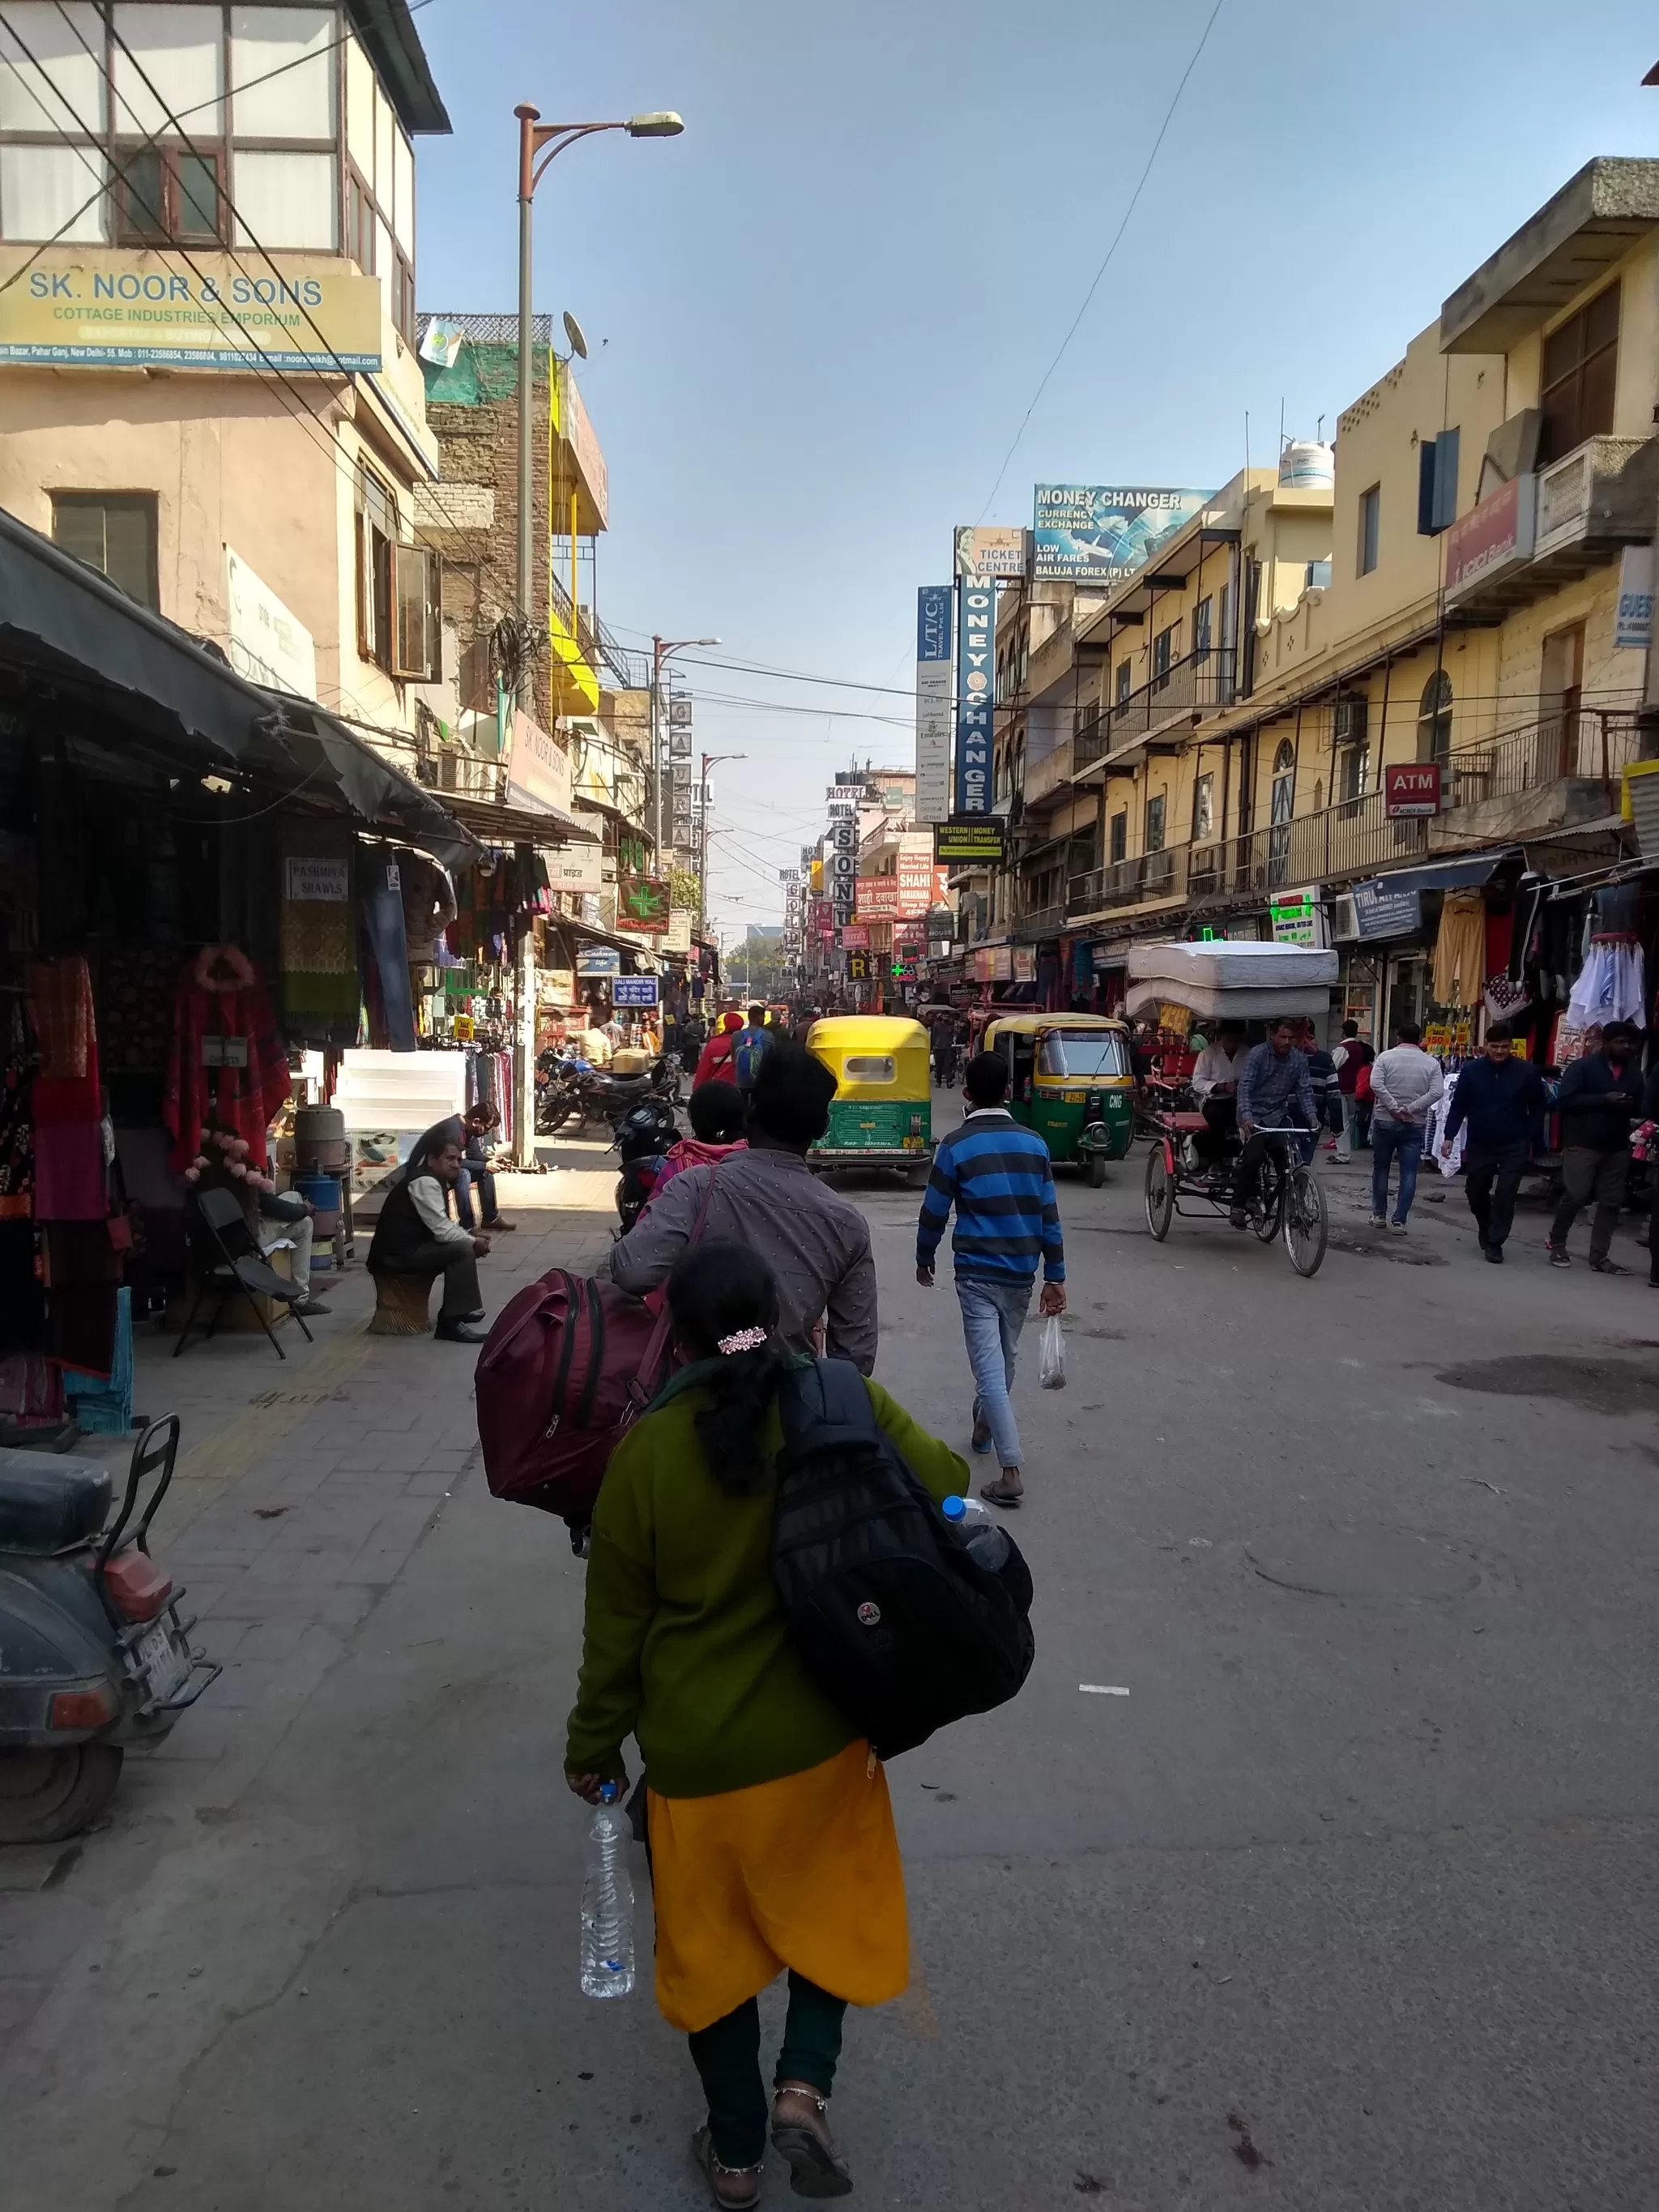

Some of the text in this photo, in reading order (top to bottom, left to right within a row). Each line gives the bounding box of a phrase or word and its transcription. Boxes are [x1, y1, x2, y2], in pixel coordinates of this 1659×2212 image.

[29, 272, 322, 306] SK. NOOR & SONS
[53, 307, 300, 327] COTTAGE INDUSTRIES EMPORIUM
[70, 347, 85, 357] New
[1038, 490, 1182, 510] MONEY CHANGER
[1038, 510, 1095, 519] CURRENCY
[1038, 520, 1094, 530] EXCHANGE
[980, 549, 1022, 559] TICKET
[1037, 544, 1060, 553] LOW
[1036, 554, 1090, 562] AIR FARES
[978, 562, 1024, 572] CENTRE
[1036, 566, 1137, 578] BALUJA FOREX (P) LT
[966, 575, 991, 666] MONEY
[534, 733, 548, 763] NOOR
[552, 749, 565, 777] SONS
[965, 692, 987, 810] CHANGER
[1393, 774, 1433, 790] ATM
[826, 787, 865, 799] HOTEL
[830, 804, 853, 818] HOTEL
[779, 869, 800, 881] HOTEL
[900, 873, 930, 887] SHAHI
[301, 882, 343, 894] SHAWLS
[857, 889, 898, 905] शाही दवाखा
[1109, 1094, 1123, 1108] CNG
